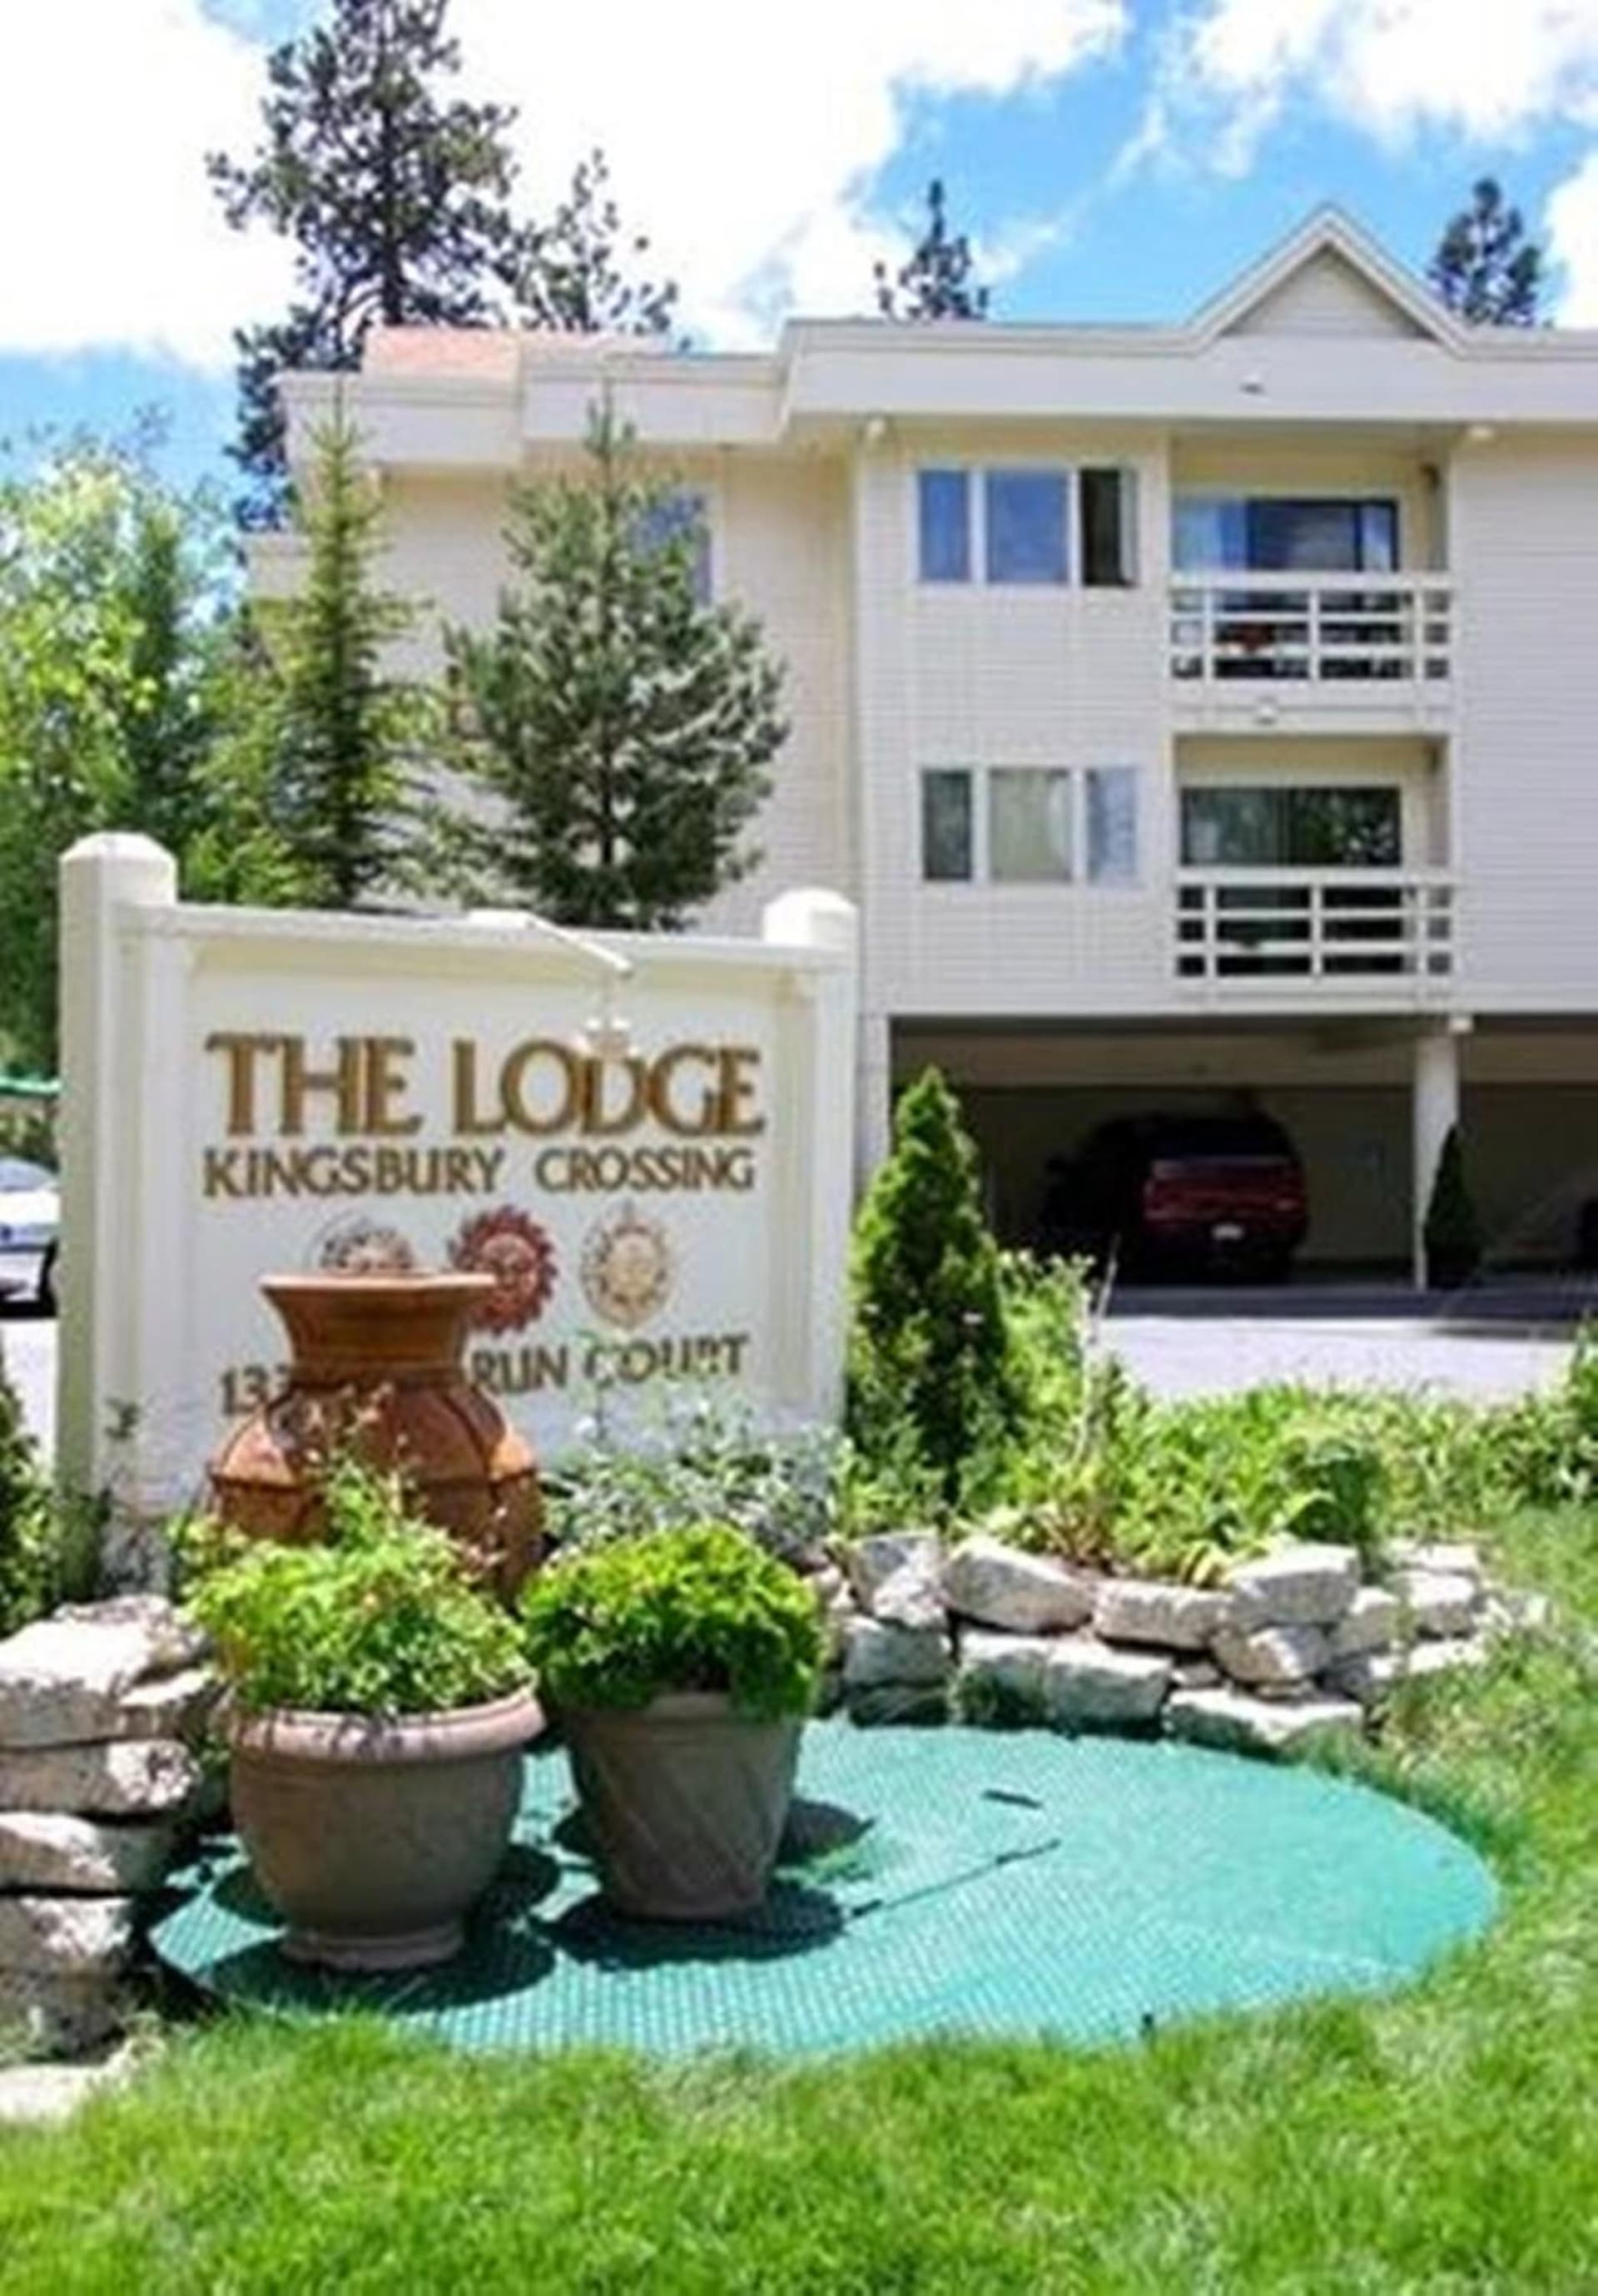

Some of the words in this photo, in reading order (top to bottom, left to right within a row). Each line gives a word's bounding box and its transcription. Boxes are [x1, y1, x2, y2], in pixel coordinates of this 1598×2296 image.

[205, 1032, 423, 1137] THE
[453, 1038, 766, 1138] LODGE
[204, 1147, 504, 1198] KINGSBURY
[535, 1146, 755, 1192] CROSSING
